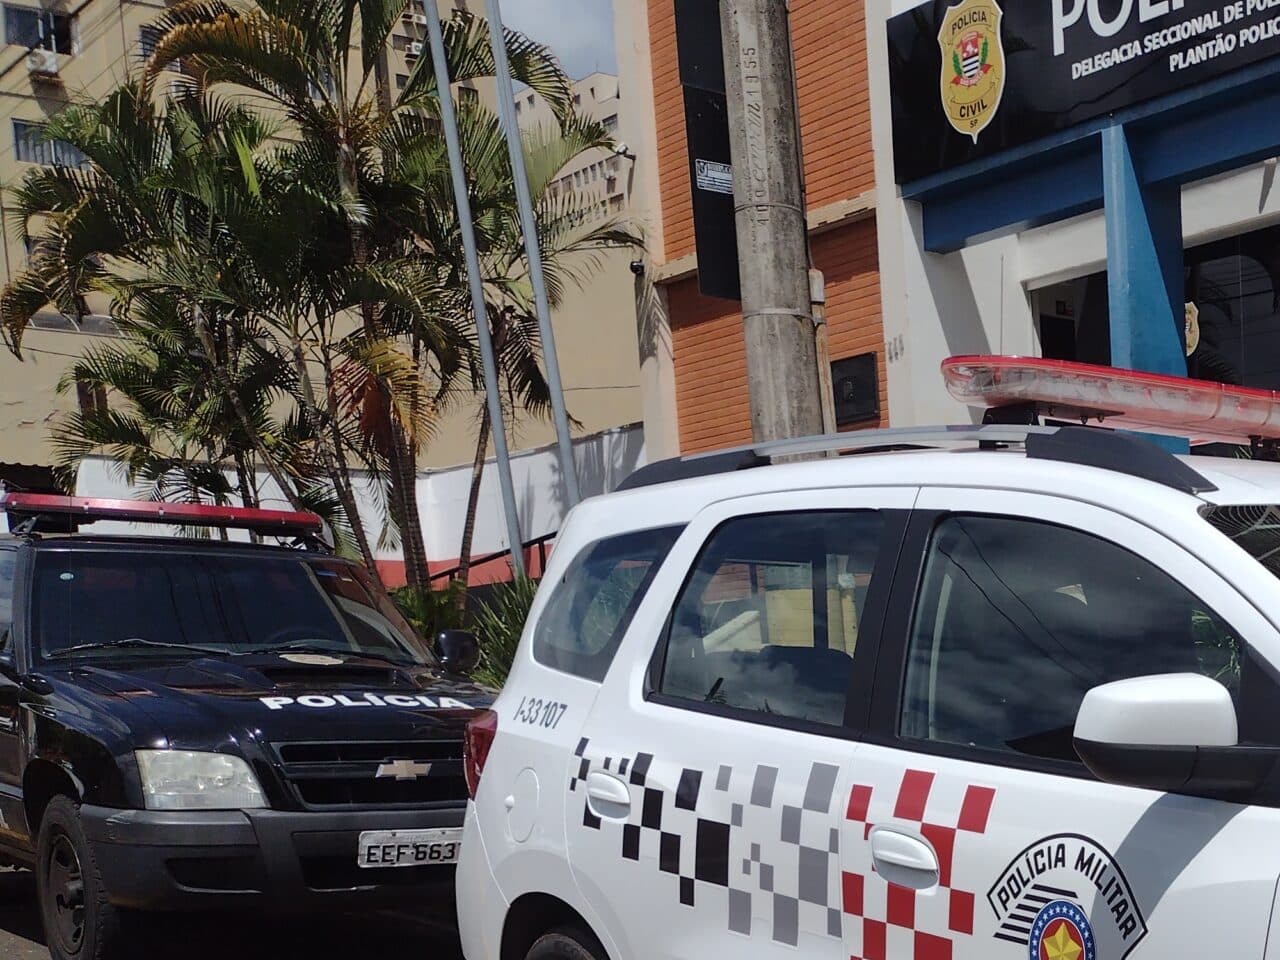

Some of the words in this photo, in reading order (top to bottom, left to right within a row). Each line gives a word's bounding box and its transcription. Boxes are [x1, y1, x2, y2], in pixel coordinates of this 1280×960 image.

[1071, 40, 1142, 80] DELEGACIA
[1143, 10, 1221, 53] SECCIONAL
[1223, 1, 1244, 24] DE
[1169, 33, 1237, 72] PLANTÃO
[959, 99, 988, 118] CIVIL
[969, 119, 979, 128] SP
[259, 692, 475, 710] POLÍCIA
[414, 842, 461, 861] 663
[997, 843, 1066, 912] POLÍCIA
[1074, 846, 1137, 940] MILITAR
